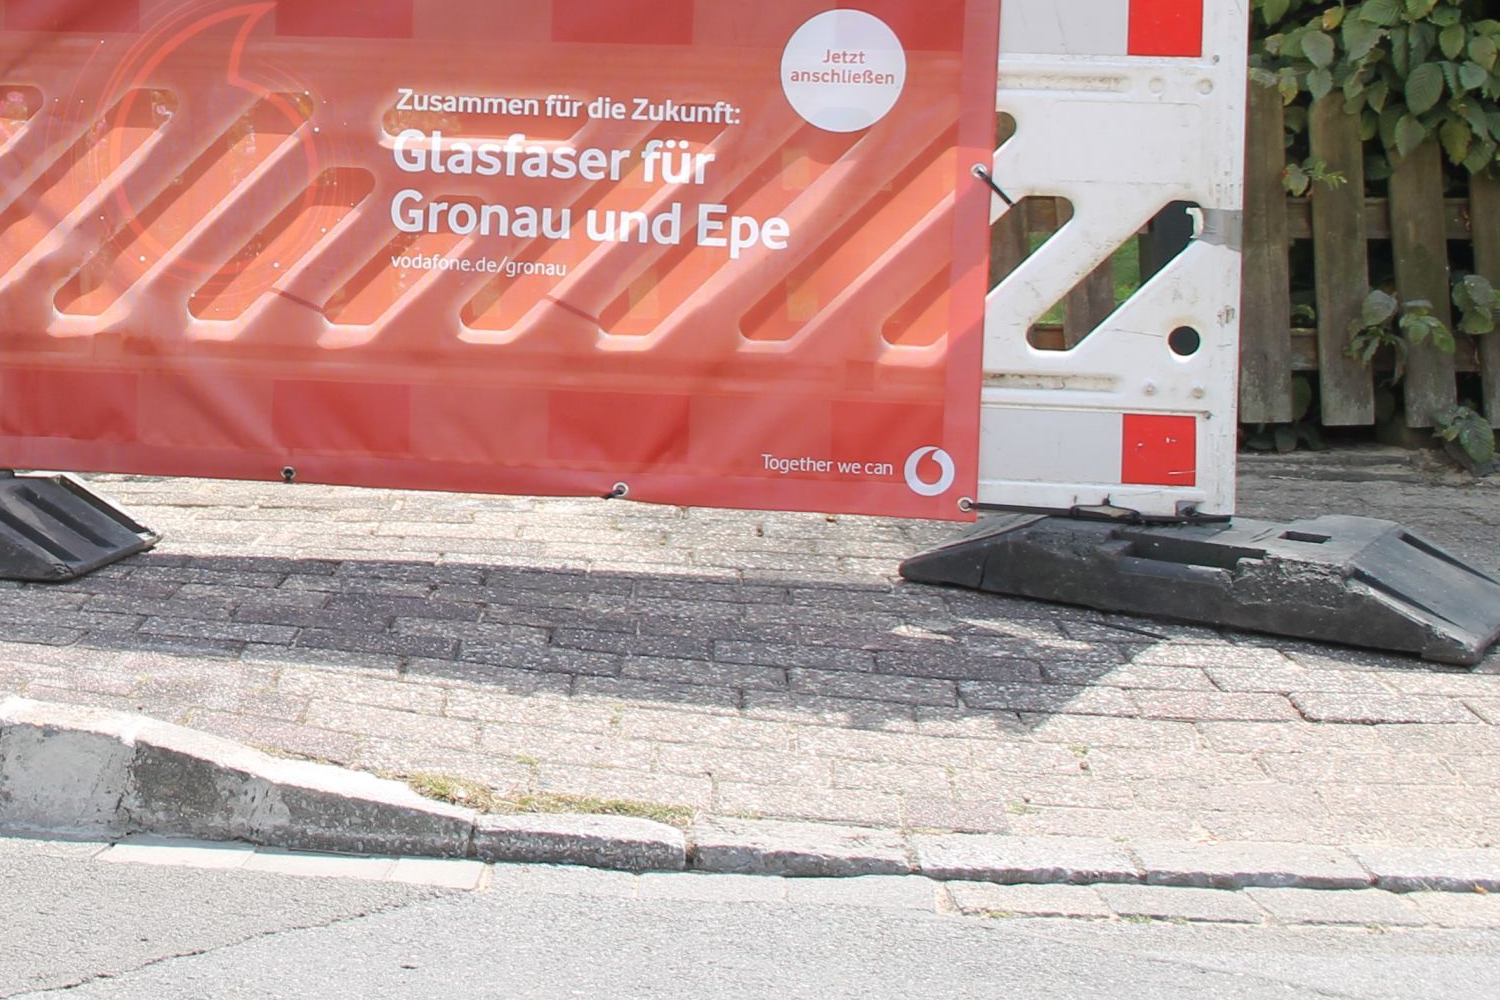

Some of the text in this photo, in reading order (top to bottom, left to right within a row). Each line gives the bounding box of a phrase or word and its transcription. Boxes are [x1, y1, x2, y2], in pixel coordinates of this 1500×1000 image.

[822, 49, 866, 64] Jetzt
[790, 69, 895, 85] anschließen
[396, 87, 741, 125] Zusammen für die Zukunft:
[392, 128, 716, 185] Glasfaser für
[390, 189, 790, 259] Gronau und Epe
[391, 252, 567, 278] vodafone.de/gronau
[761, 453, 893, 475] Together we can
